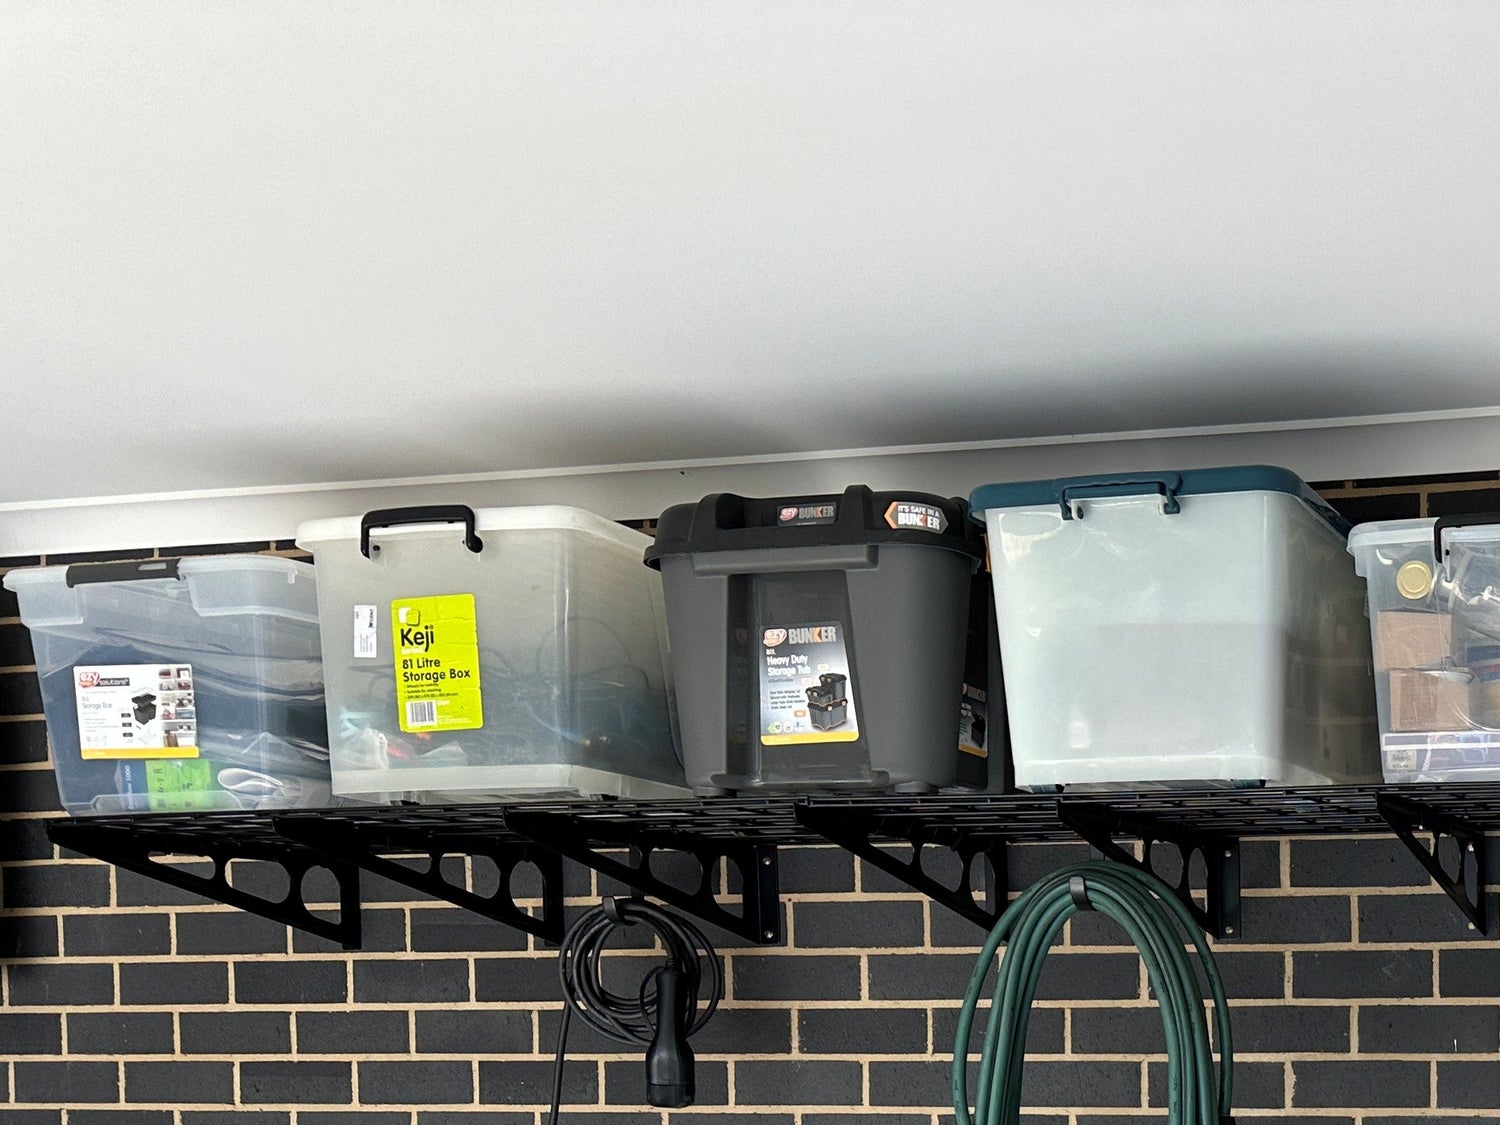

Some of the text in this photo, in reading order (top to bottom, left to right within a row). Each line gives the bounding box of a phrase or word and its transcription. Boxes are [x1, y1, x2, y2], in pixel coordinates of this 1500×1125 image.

[799, 506, 834, 519] BUNKER
[898, 512, 940, 530] BUNKER
[400, 624, 435, 652] Keji
[788, 626, 837, 645] BUNKER
[402, 657, 440, 669] 81 Litre
[767, 654, 808, 666] Heavy Duty
[403, 668, 470, 683] Storage Box
[767, 665, 811, 677] Storage Tub
[80, 672, 101, 686] ezy
